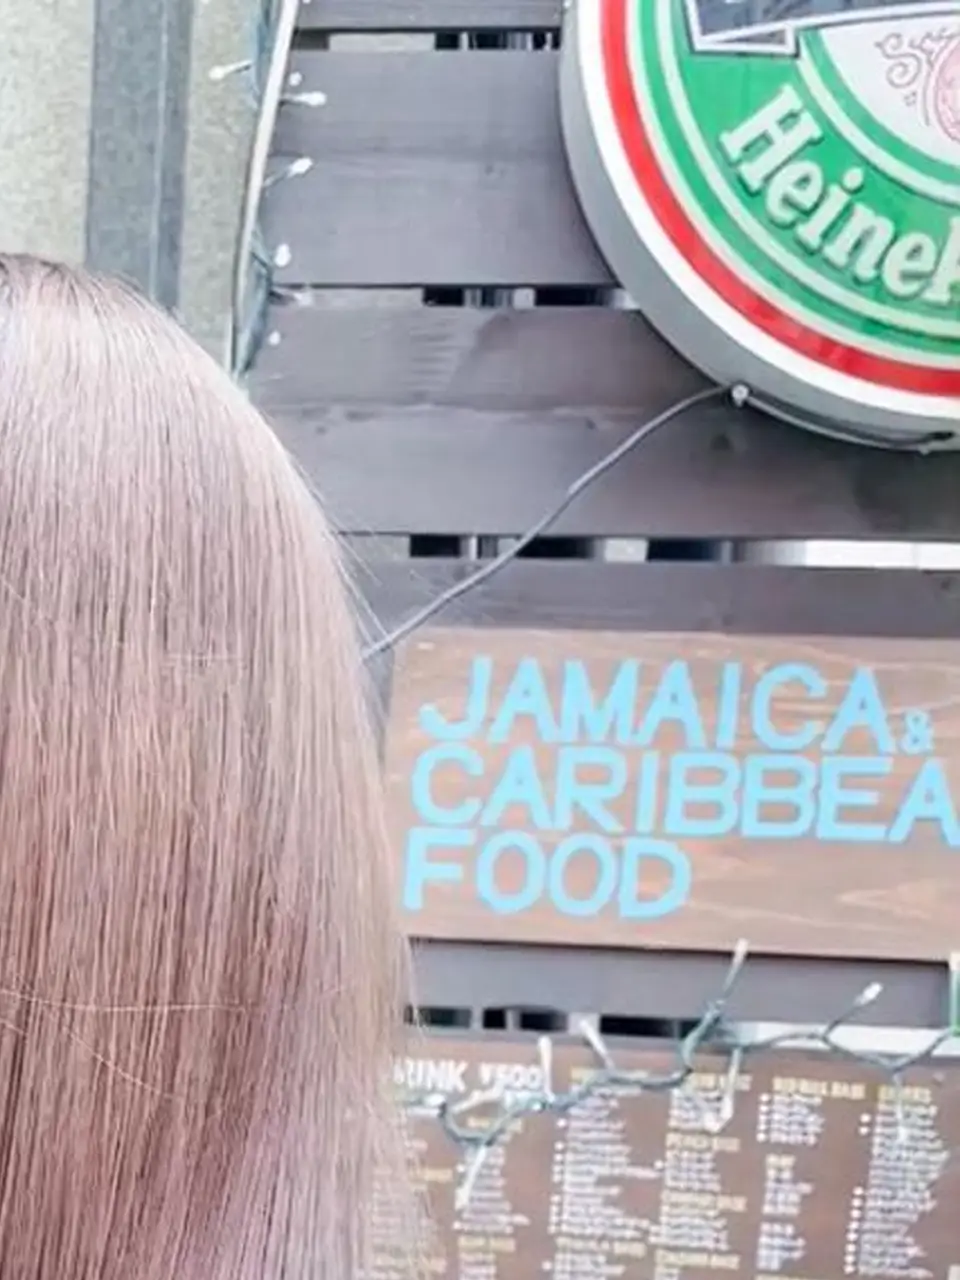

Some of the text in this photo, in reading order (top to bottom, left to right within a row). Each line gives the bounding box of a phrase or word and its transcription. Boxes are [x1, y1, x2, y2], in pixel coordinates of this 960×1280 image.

[418, 655, 896, 754] JAMAICA
[410, 743, 960, 846] CARIBBEA
[401, 826, 693, 919] FOOD
